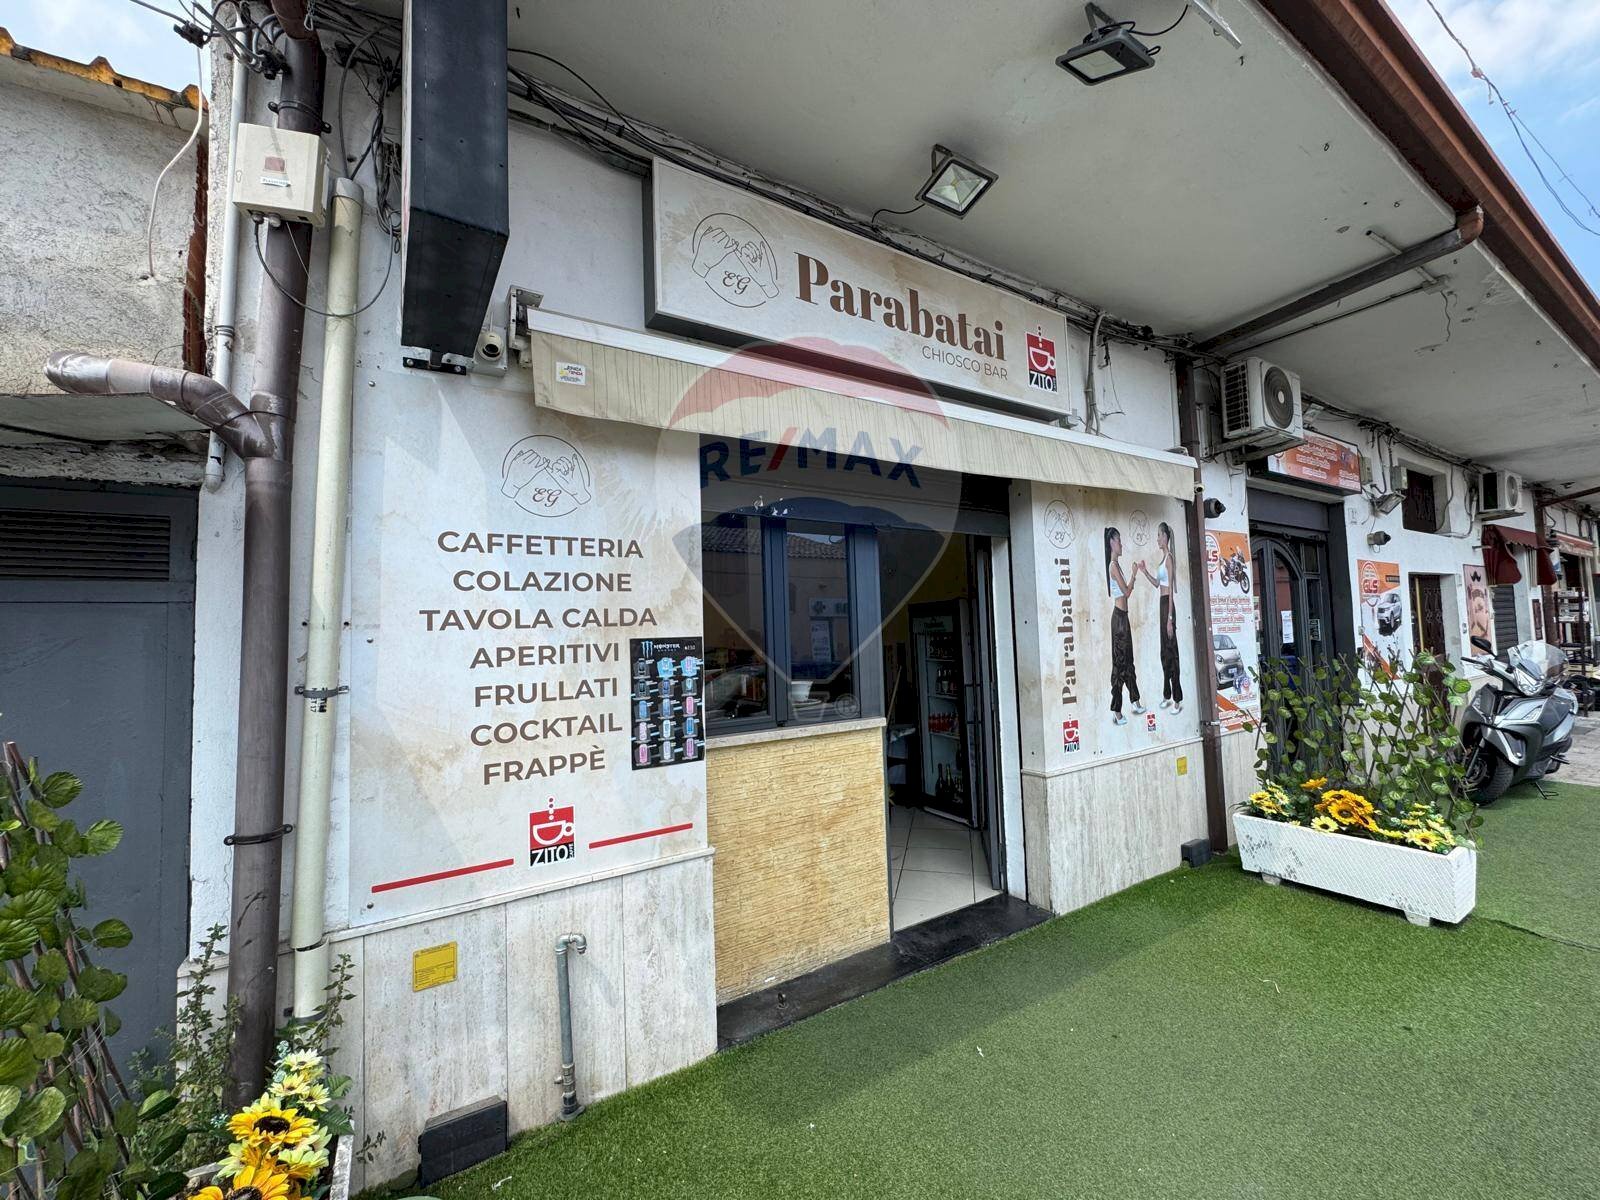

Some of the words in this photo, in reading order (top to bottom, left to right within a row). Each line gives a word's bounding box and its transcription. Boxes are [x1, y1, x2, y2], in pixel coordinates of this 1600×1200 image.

[794, 251, 1008, 361] Parabatai
[922, 345, 981, 373] CHIOSCO
[984, 363, 1008, 381] BAR
[1029, 370, 1053, 391] ZITO
[437, 531, 644, 558] CAFFETTERIA
[453, 570, 632, 592] COLAZIONE
[419, 608, 554, 632] TAVOLA
[562, 608, 658, 628] CALDA
[1054, 558, 1077, 704] Parabatai
[470, 643, 619, 669] APERITIVI
[475, 678, 618, 707] FRULLATI
[470, 713, 623, 747] COCKTAIL
[483, 745, 606, 785] FRAPPÈ
[530, 845, 569, 867] ZITO
